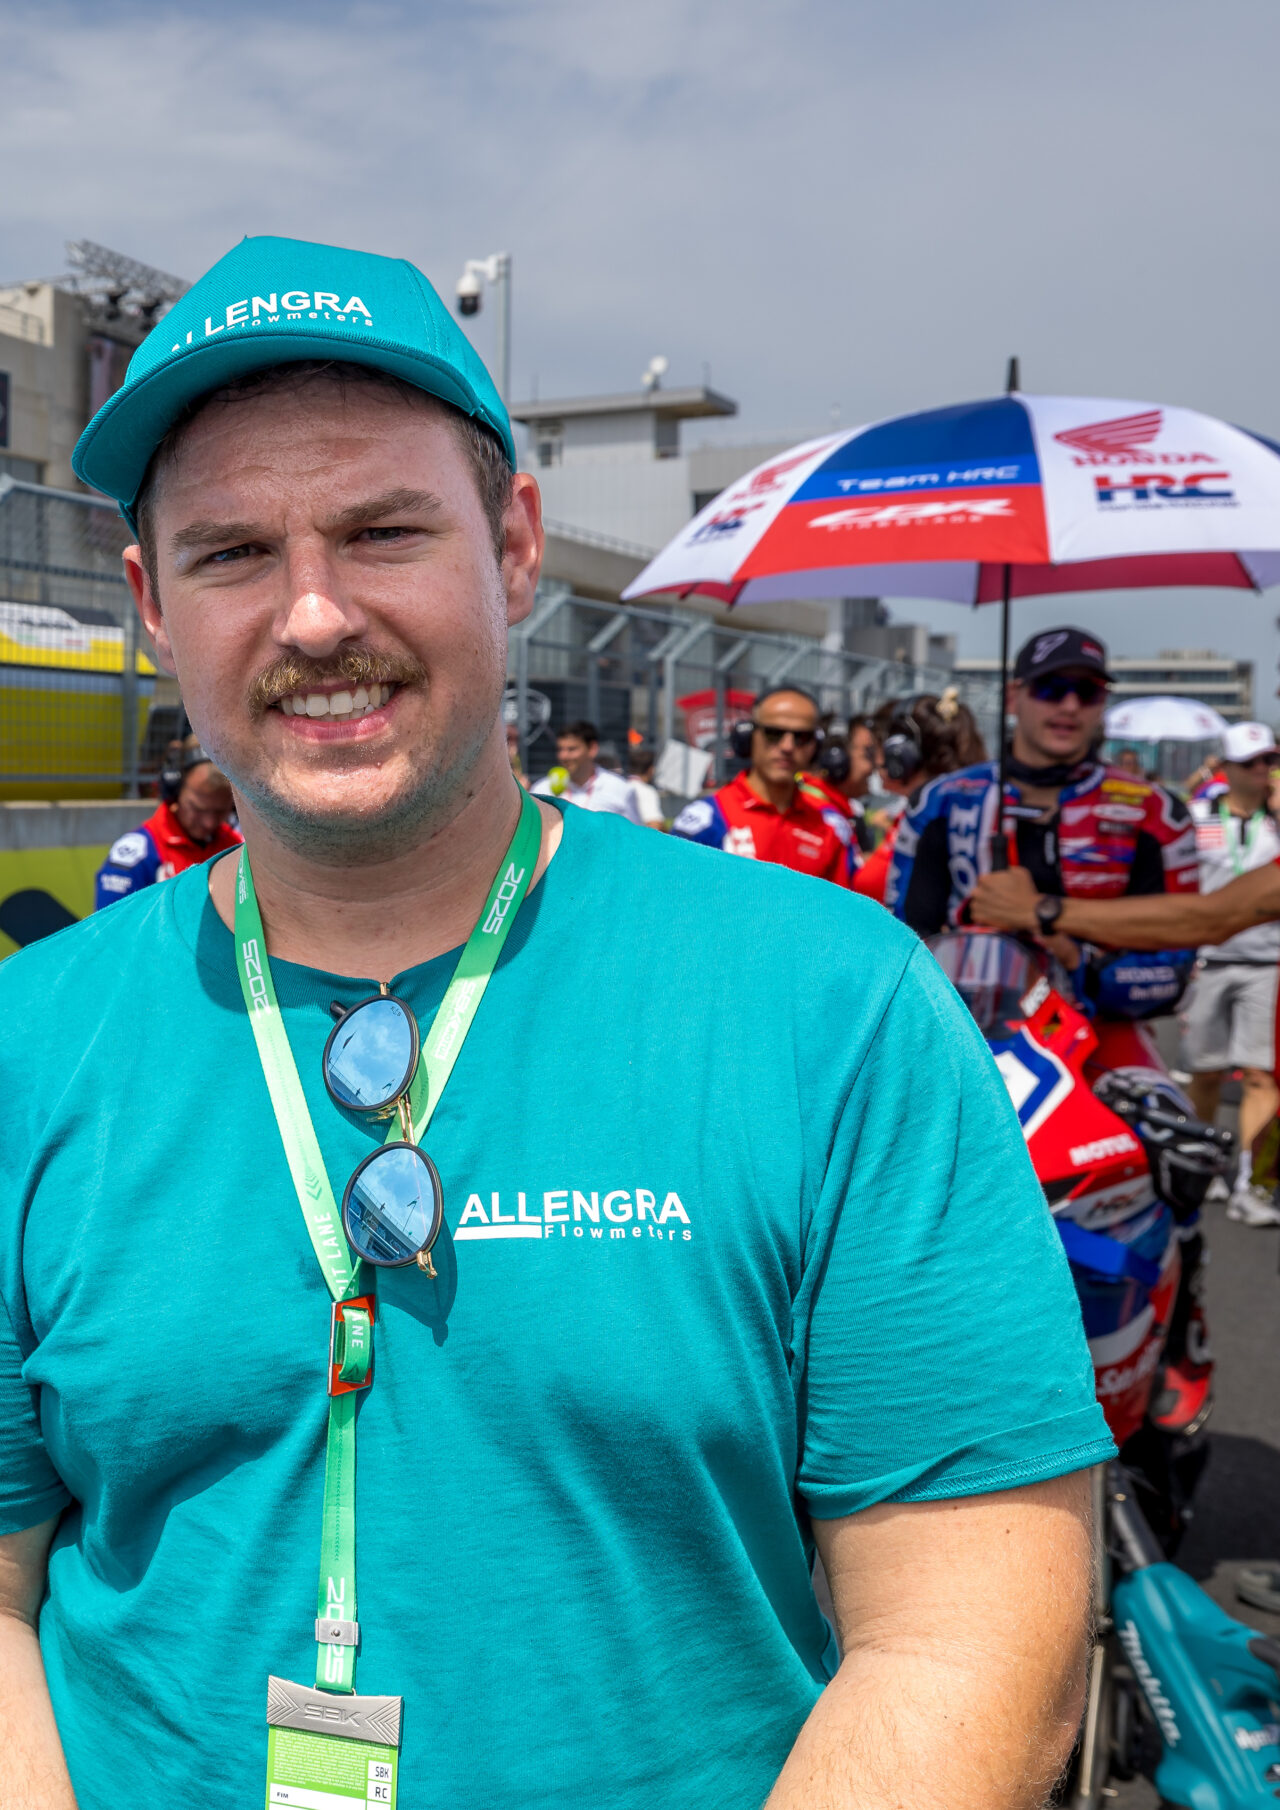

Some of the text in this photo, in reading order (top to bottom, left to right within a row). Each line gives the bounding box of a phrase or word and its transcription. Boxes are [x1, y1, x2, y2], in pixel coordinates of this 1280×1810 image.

[227, 311, 373, 331] lowmeters
[1071, 451, 1219, 467] HONDA
[946, 464, 1022, 483] HRC
[1094, 471, 1234, 502] HRC
[481, 862, 526, 935] 2025
[242, 938, 272, 1020] 2025
[1069, 1132, 1139, 1167] MOTUL
[458, 1188, 692, 1225] ALLENGRA
[314, 1211, 342, 1260] LANE
[544, 1224, 693, 1241] Flowmeters
[304, 1702, 361, 1728] SBK
[375, 1766, 390, 1779] SBK
[276, 1791, 289, 1799] FIM
[375, 1786, 388, 1800] RC
